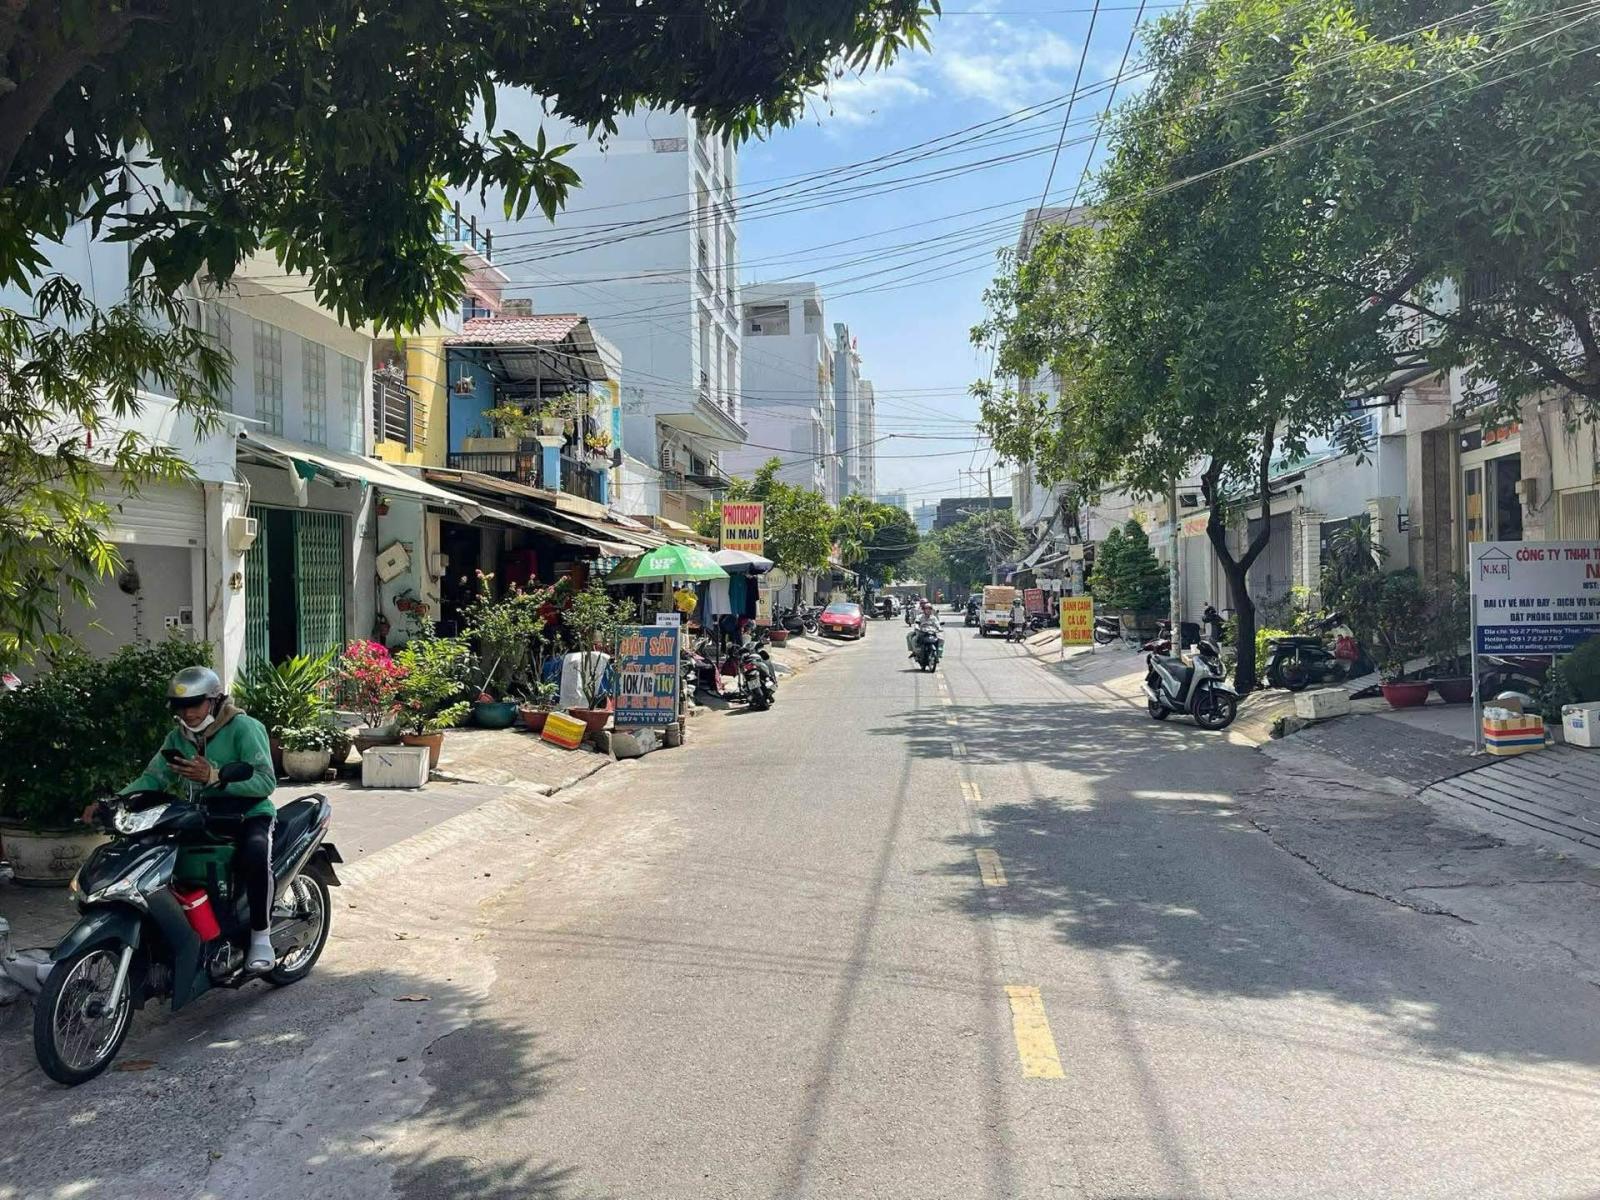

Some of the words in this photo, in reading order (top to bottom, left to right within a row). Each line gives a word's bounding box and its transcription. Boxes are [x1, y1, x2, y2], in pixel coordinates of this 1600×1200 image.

[723, 505, 761, 525] PHOTOCOPY
[726, 529, 736, 540] IN
[738, 527, 760, 540] MÀU
[1516, 547, 1545, 561] CÔNG
[1547, 549, 1561, 560] TY
[1564, 548, 1590, 560] TNHH
[649, 631, 675, 656] SẤY
